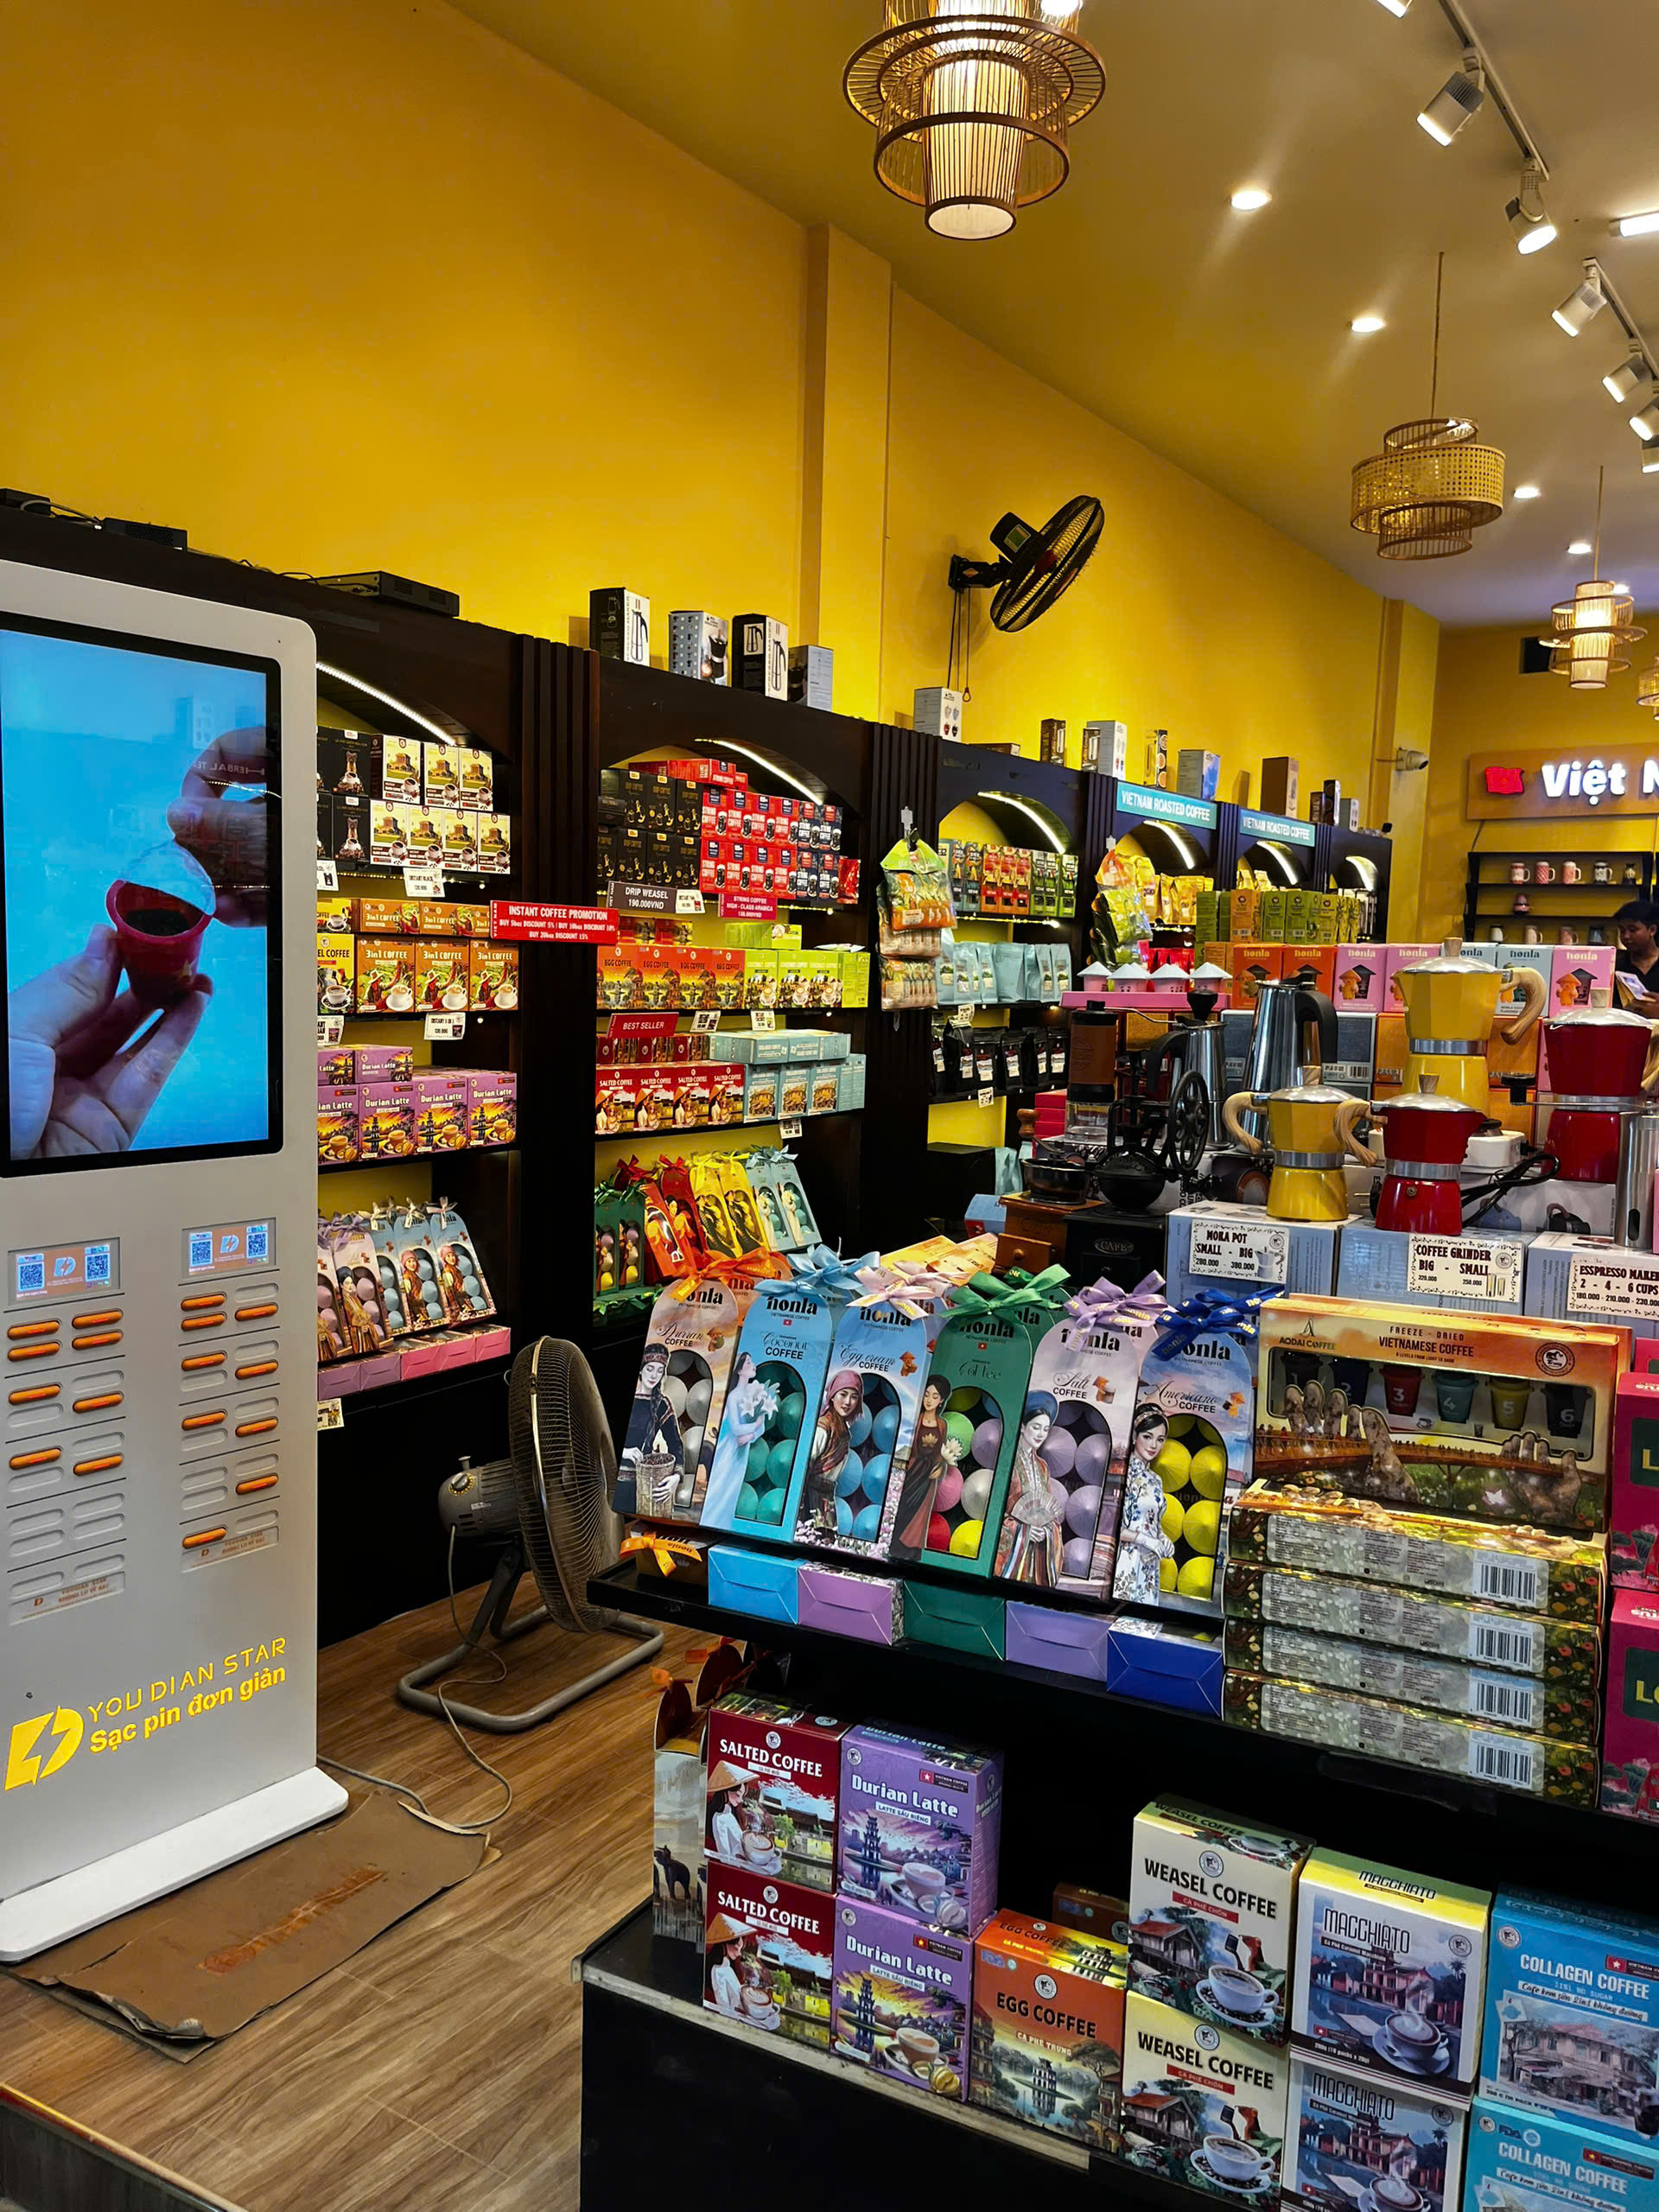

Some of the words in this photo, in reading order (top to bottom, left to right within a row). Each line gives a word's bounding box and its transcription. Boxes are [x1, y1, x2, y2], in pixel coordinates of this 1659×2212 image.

[1541, 759, 1626, 805] Việt
[1122, 790, 1152, 810] VIETNAM
[1154, 797, 1185, 817] ROASTED
[1185, 804, 1211, 822] COFFEE
[1242, 816, 1266, 830] VIETNAM
[1265, 821, 1289, 836] ROASTED
[1289, 826, 1311, 841] COFFEE
[625, 887, 641, 897] DRIP
[642, 888, 669, 899] WEASEL
[508, 906, 538, 917] INSTANT
[540, 907, 567, 918] COFFEE
[569, 909, 607, 920] PROMOTION
[628, 899, 664, 910] 190.000VND
[366, 950, 381, 958] 3in1
[384, 950, 408, 959] COFFEE
[423, 950, 438, 960] 3in1
[440, 951, 462, 960] COFFEE
[477, 951, 491, 960] 3in1
[1460, 948, 1483, 957] onla
[1206, 1230, 1230, 1243] MOKA
[1231, 1233, 1248, 1244] POT
[1196, 1243, 1222, 1255] SMALL
[1239, 1247, 1253, 1258] BIG
[1416, 1244, 1448, 1259] COFFEE
[1450, 1247, 1491, 1262] GRINDER
[1230, 1261, 1255, 1270] 380.000
[1419, 1259, 1434, 1272] BIG
[1459, 1264, 1490, 1276] SMALL
[1580, 1265, 1627, 1278] ESSPRESSO
[1580, 1278, 1586, 1288] 2
[1605, 1280, 1611, 1290] 4
[1628, 1282, 1634, 1293] 6
[1636, 1283, 1659, 1295] CUPS
[686, 1287, 723, 1305] onla
[1605, 1294, 1630, 1303] 210.000
[766, 1296, 817, 1315] nonla
[1389, 1325, 1424, 1337] FREEZE
[1436, 1331, 1465, 1341] DRIED
[664, 1338, 693, 1347] COFFEE
[1183, 1340, 1230, 1361] onla
[1279, 1337, 1306, 1346] AODAI
[1306, 1340, 1335, 1350] COFFEE
[1379, 1336, 1437, 1353] VIETNAMESE
[1439, 1343, 1474, 1357] COFFEE
[766, 1346, 804, 1360] COFFEE
[859, 1361, 889, 1372] COFFEE
[1052, 1387, 1088, 1399] COFFEE
[1393, 1388, 1405, 1402] 3
[1179, 1401, 1217, 1414] COFFEE
[1443, 1396, 1456, 1410] 4
[1503, 1401, 1514, 1414] 5
[1560, 1408, 1574, 1422] 6
[87, 1688, 143, 1722] YOU
[150, 1662, 214, 1702] DIAN
[223, 1637, 286, 1675] STAR
[90, 1719, 137, 1753] Sạc
[143, 1705, 181, 1739] pin
[187, 1685, 233, 1717] đơn
[239, 1666, 286, 1702] giản
[719, 1738, 769, 1764] SALTED
[772, 1753, 823, 1777] COFFEE
[851, 1774, 908, 1804] Durian
[912, 1791, 959, 1818] Latte
[878, 1804, 896, 1815] LATTE
[1154, 1802, 1198, 1823] WEASEL
[1200, 1819, 1244, 1835] COFFEE
[1144, 1858, 1207, 1896] WEASEL
[1212, 1883, 1277, 1919] COFFEE
[1359, 1870, 1436, 1900] MACCHIATO
[717, 1891, 766, 1918] SALTED
[769, 1908, 820, 1935] COFFEE
[1000, 1923, 1021, 1934] EGG
[1024, 1930, 1067, 1948] COFFEE
[1324, 1907, 1410, 1954] MACCHIATO
[847, 1935, 902, 1968] Durian
[906, 1956, 952, 1986] Latte
[1520, 1954, 1593, 1986] COLLAGEN
[1597, 1974, 1650, 1999] COFFEE
[997, 1992, 1029, 2017] EGG
[1033, 2005, 1096, 2038] COFFEE
[1138, 2031, 1203, 2069] WEASEL
[1208, 2056, 1274, 2090] COFFEE
[1313, 2072, 1395, 2120] MACCHIATO
[1499, 2142, 1571, 2177] COLLAGEN
[1575, 2165, 1628, 2196] COFFEE
